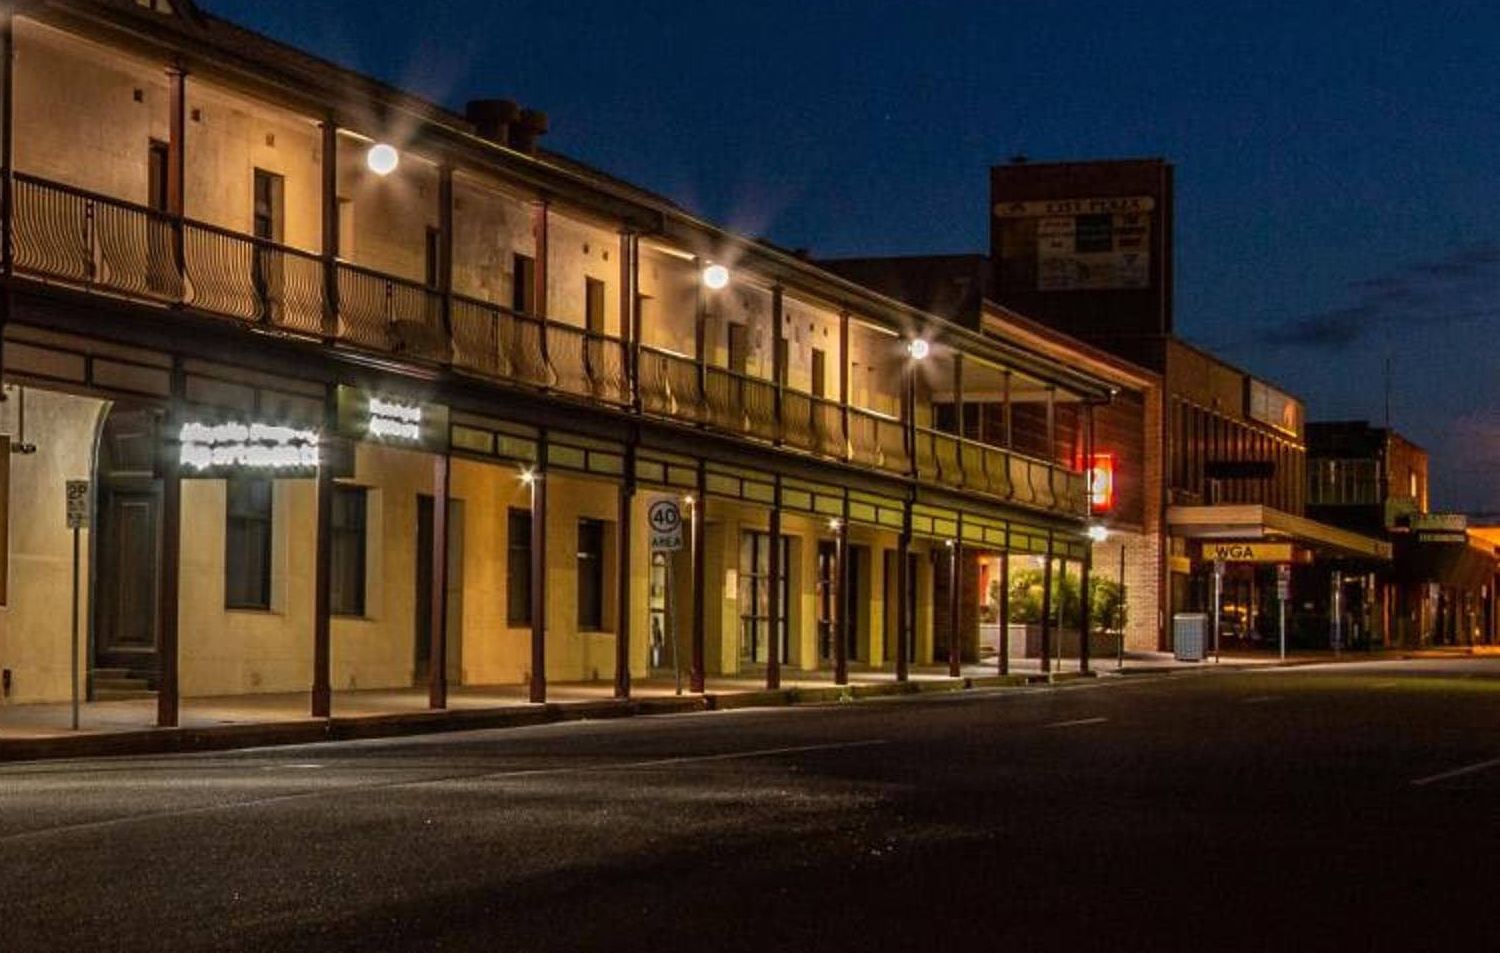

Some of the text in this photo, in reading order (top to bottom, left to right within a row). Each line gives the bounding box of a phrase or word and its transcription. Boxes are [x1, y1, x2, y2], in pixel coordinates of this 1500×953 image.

[654, 508, 677, 524] 40
[651, 537, 682, 548] AREA
[1215, 545, 1253, 560] WGA
